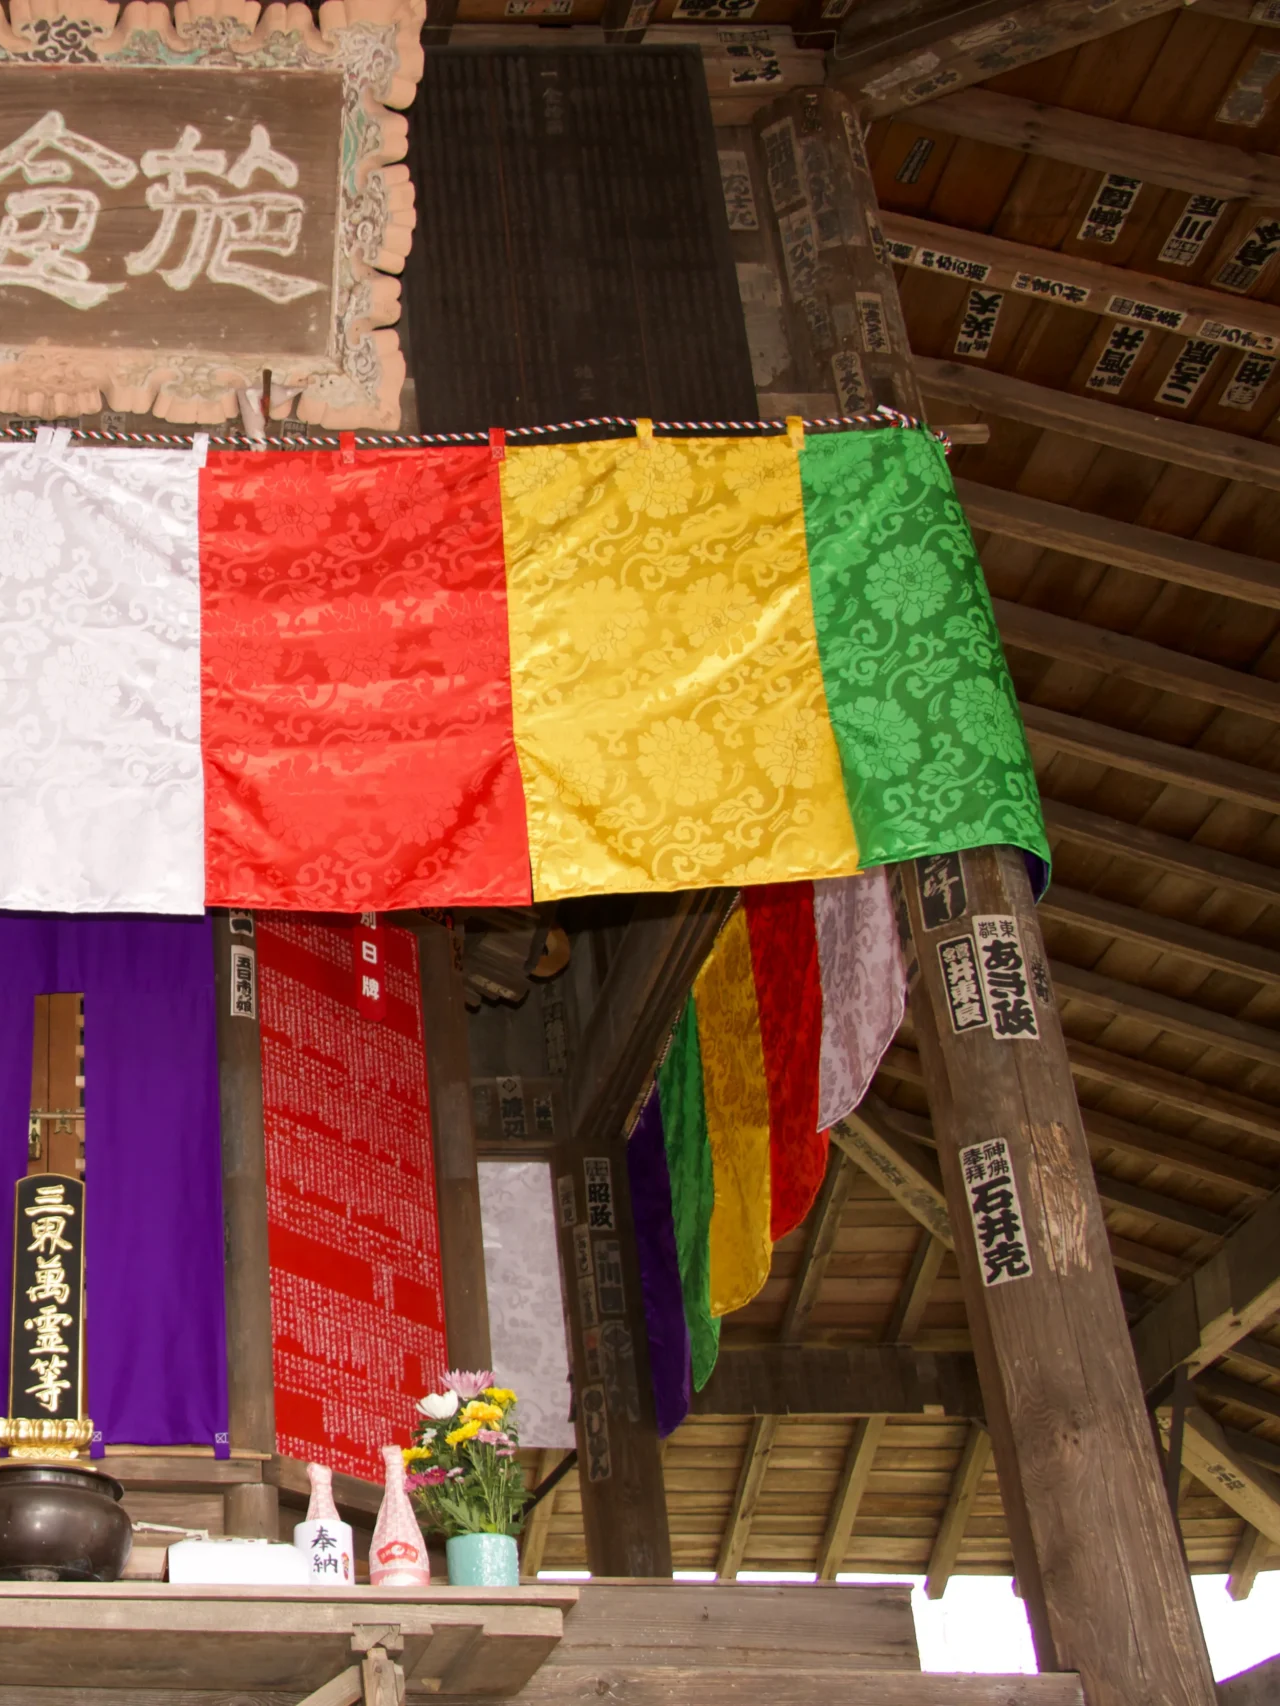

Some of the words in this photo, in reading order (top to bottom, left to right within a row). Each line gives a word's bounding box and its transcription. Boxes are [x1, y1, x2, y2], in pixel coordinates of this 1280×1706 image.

[587, 1182, 614, 1230] 昭政
[971, 1175, 1031, 1284] 石井克
[310, 1525, 339, 1574] 奉納
